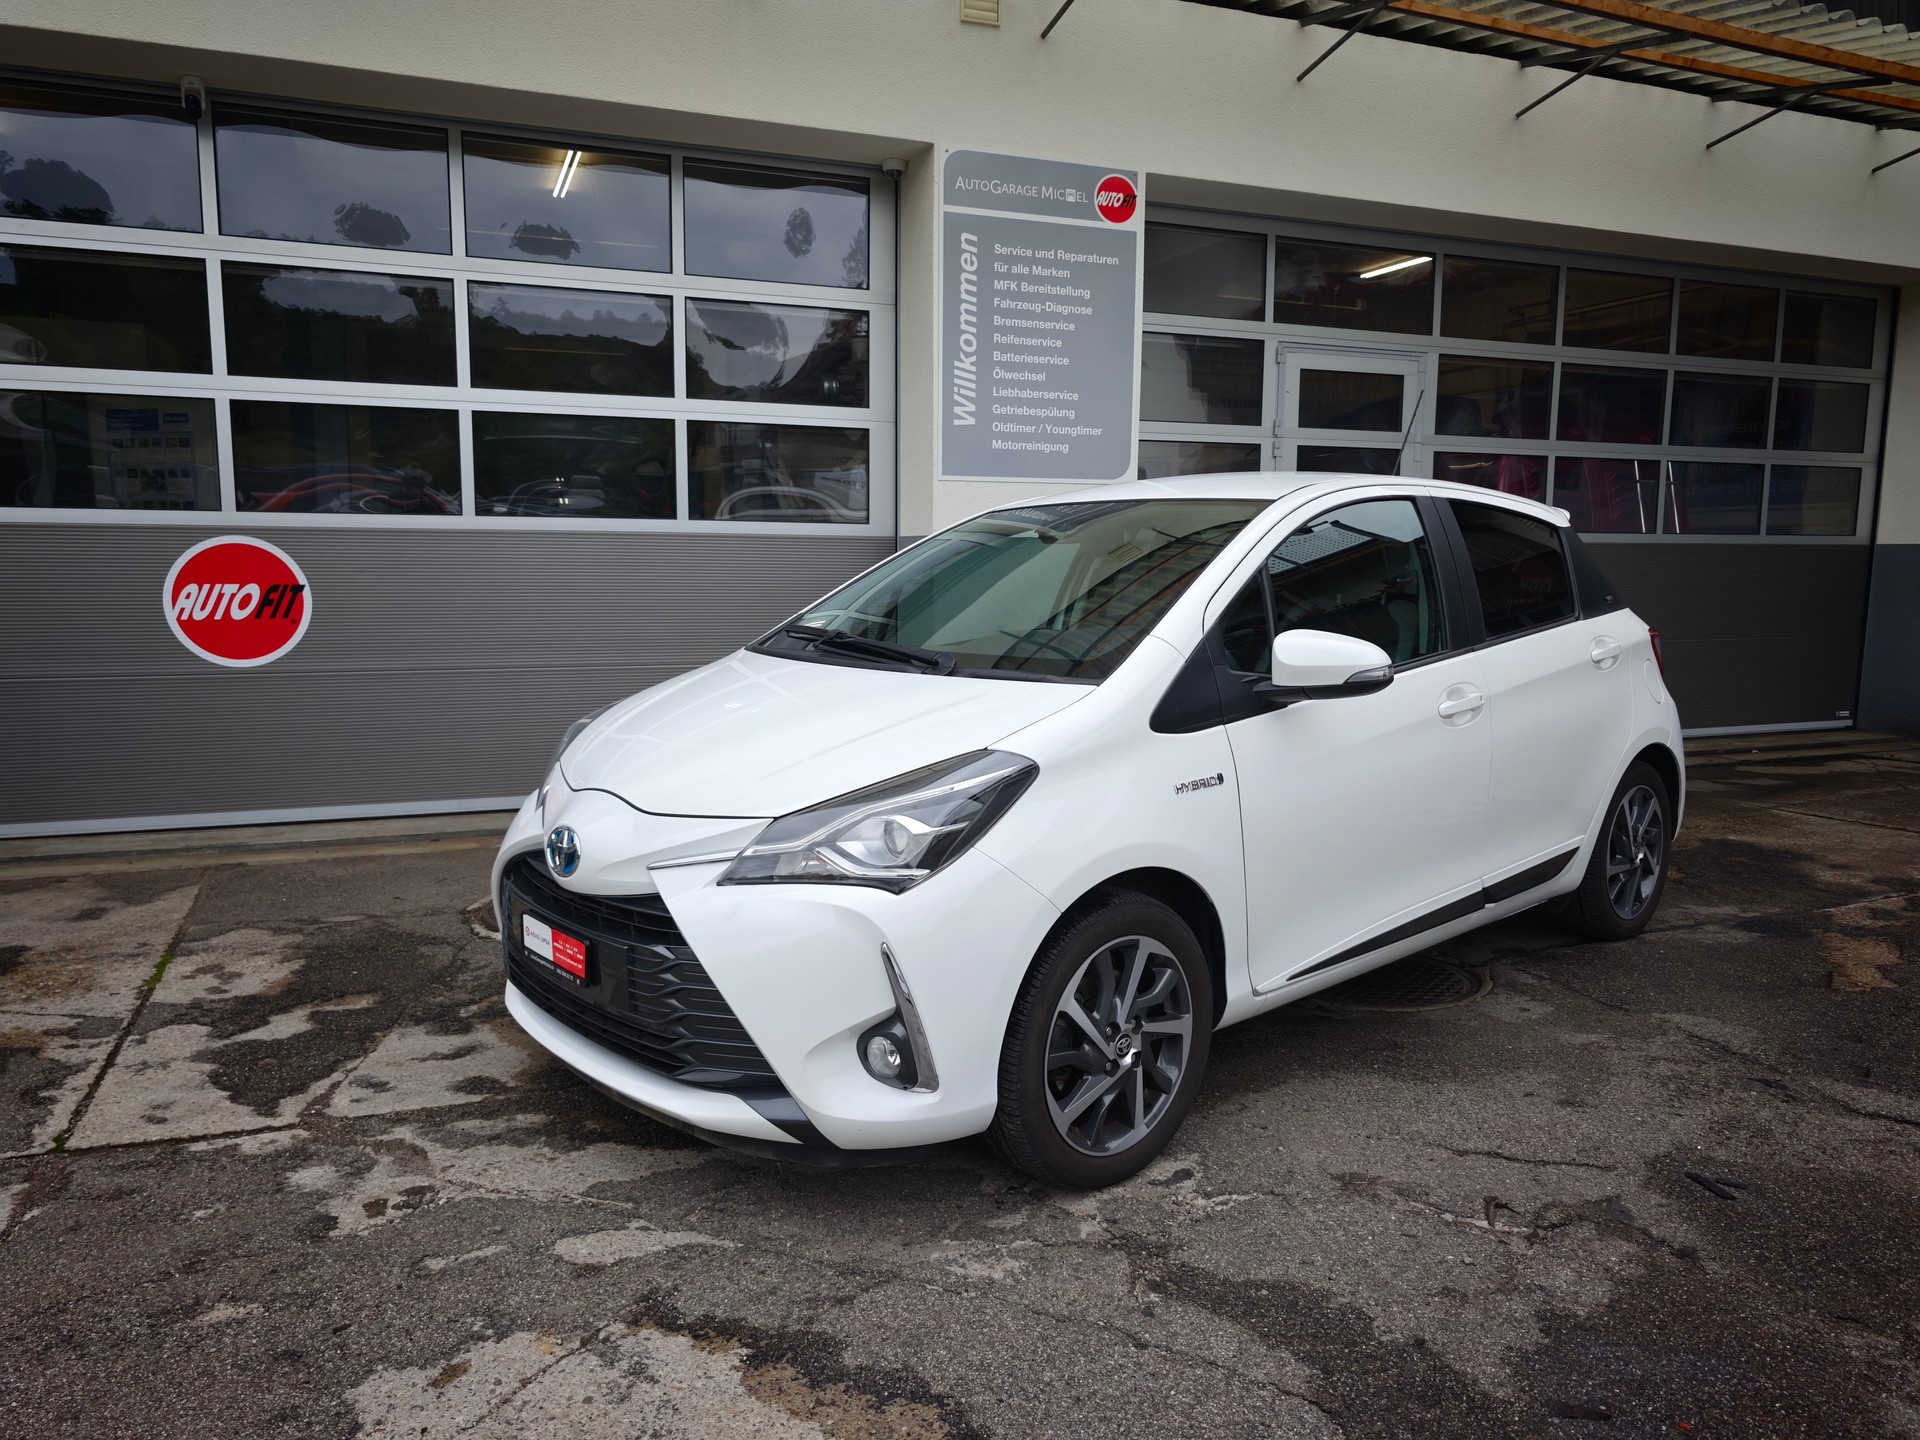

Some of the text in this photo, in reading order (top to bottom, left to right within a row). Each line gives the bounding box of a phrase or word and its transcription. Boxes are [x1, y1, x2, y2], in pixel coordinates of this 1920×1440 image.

[1097, 191, 1138, 209] AUTOFIT
[994, 243, 1119, 265] Service und Reparaturen
[994, 261, 1071, 278] für alle Marken
[994, 280, 1091, 299] MFK Bereitstellung
[994, 298, 1093, 315] Fahrzeug-Diagnose
[953, 232, 978, 426] Willkommen
[993, 316, 1076, 331] Bremsenservice
[993, 333, 1063, 347] Reifenservice
[993, 351, 1070, 365] Batterieservice
[993, 367, 1046, 381] Ölwechsel
[992, 387, 1079, 400] Liebhaberservice
[992, 404, 1076, 419] Getriebespülung
[992, 422, 1036, 433] Oldtimer
[1046, 424, 1103, 437] Youngtimer
[992, 440, 1069, 453] Motorreinigung
[174, 583, 306, 621] AUTOFIT
[1173, 776, 1218, 795] HYBRID
